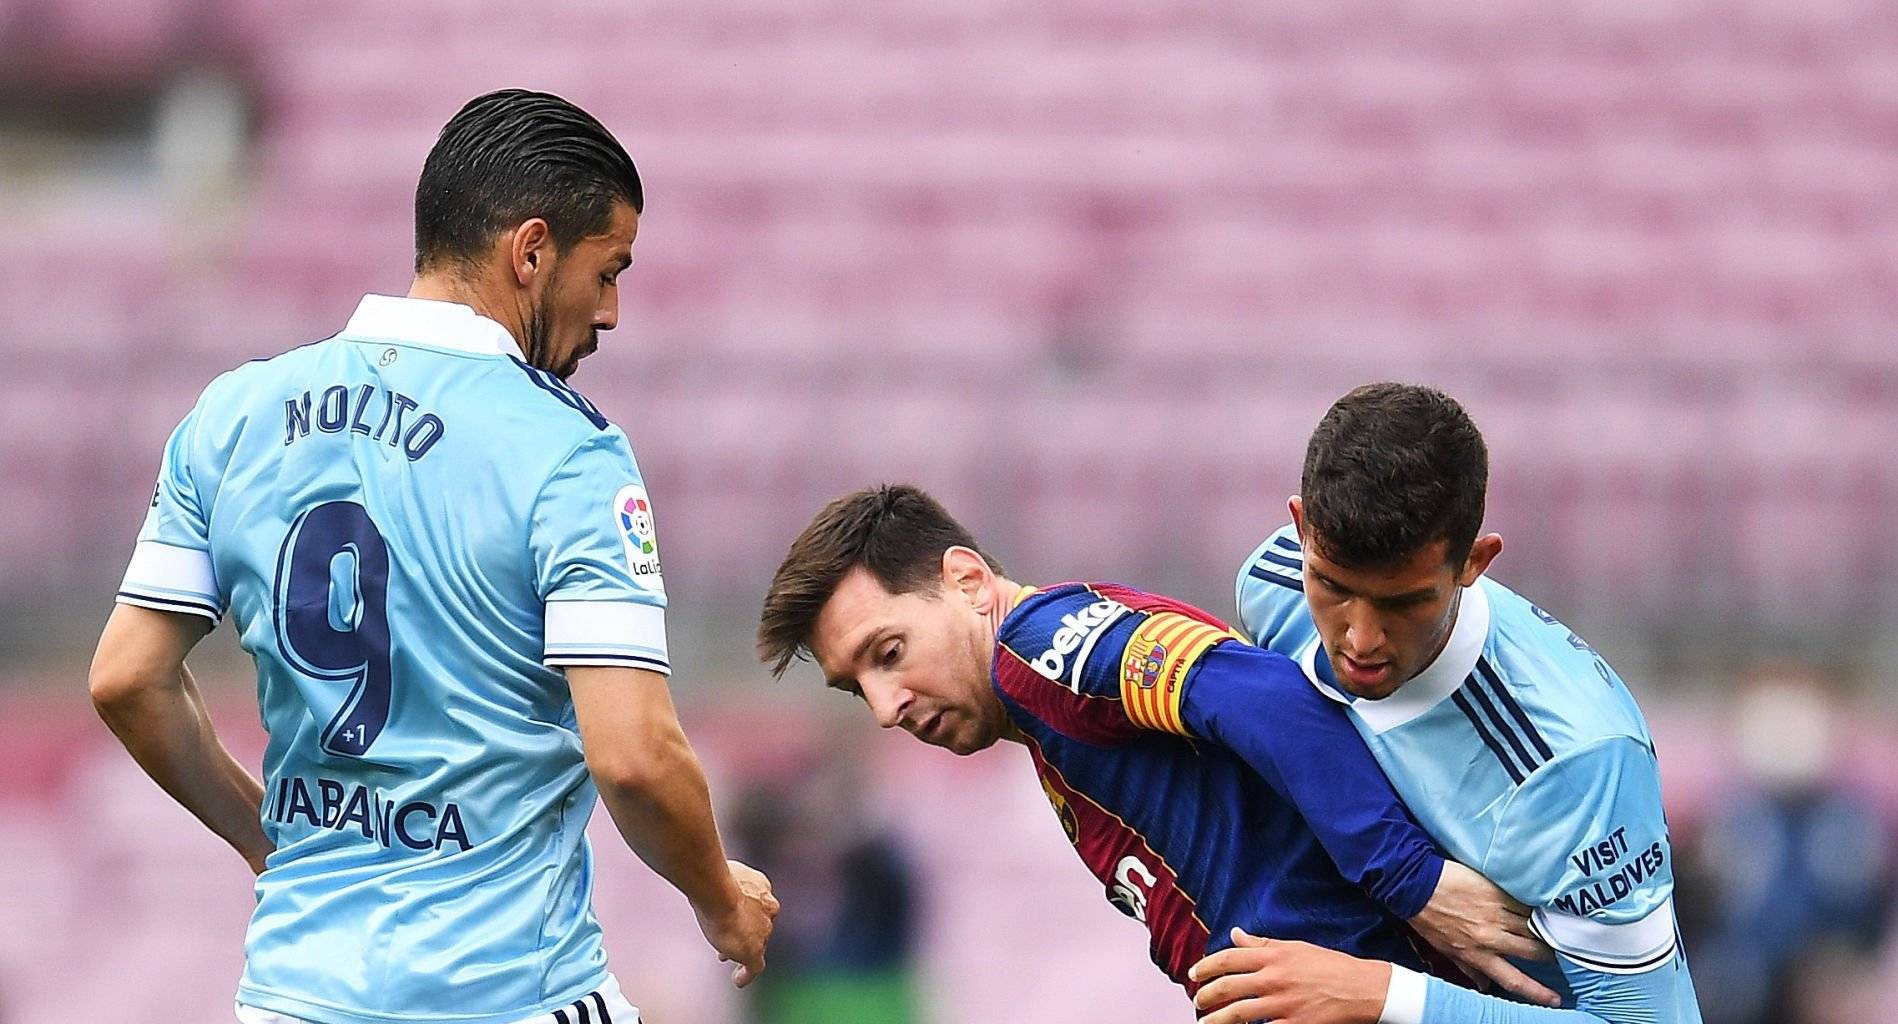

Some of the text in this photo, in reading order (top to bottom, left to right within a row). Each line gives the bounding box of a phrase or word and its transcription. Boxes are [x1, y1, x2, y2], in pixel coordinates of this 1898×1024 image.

[285, 384, 444, 462] NOLITO
[273, 500, 391, 757] 9
[1030, 600, 1119, 681] beko
[342, 724, 366, 746] +1
[1554, 842, 1664, 917] MALDIVES
[1572, 826, 1628, 877] VISIT
